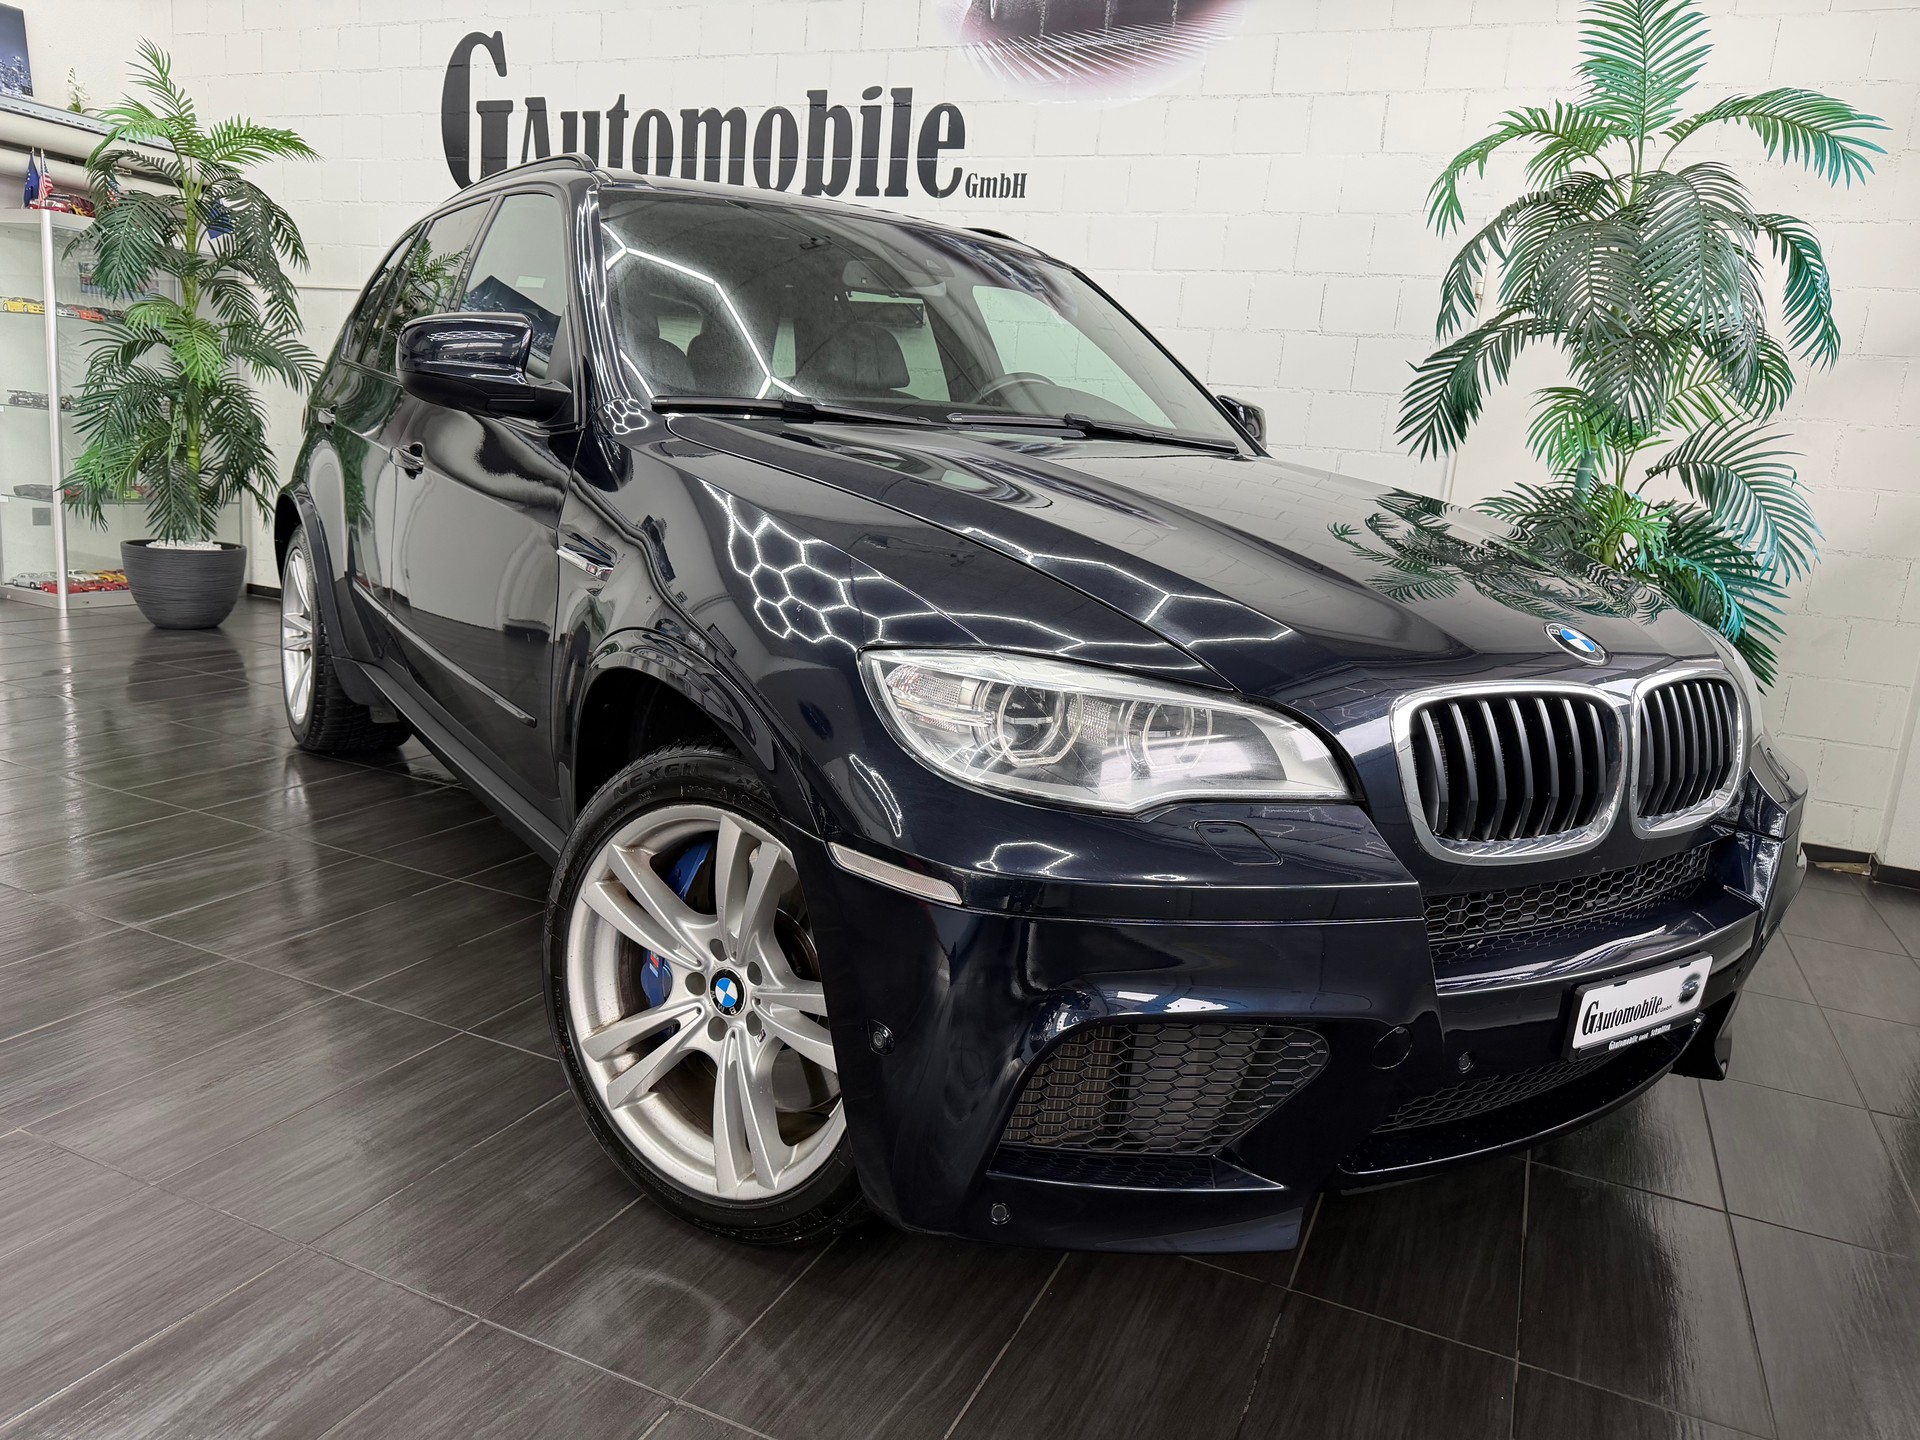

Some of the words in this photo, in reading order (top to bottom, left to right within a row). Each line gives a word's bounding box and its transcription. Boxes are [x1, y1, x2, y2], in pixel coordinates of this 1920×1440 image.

[965, 173, 1027, 198] GmbH
[613, 763, 702, 800] NEXEN
[710, 990, 737, 1015] BMW
[1582, 996, 1663, 1036] GAutomobile
